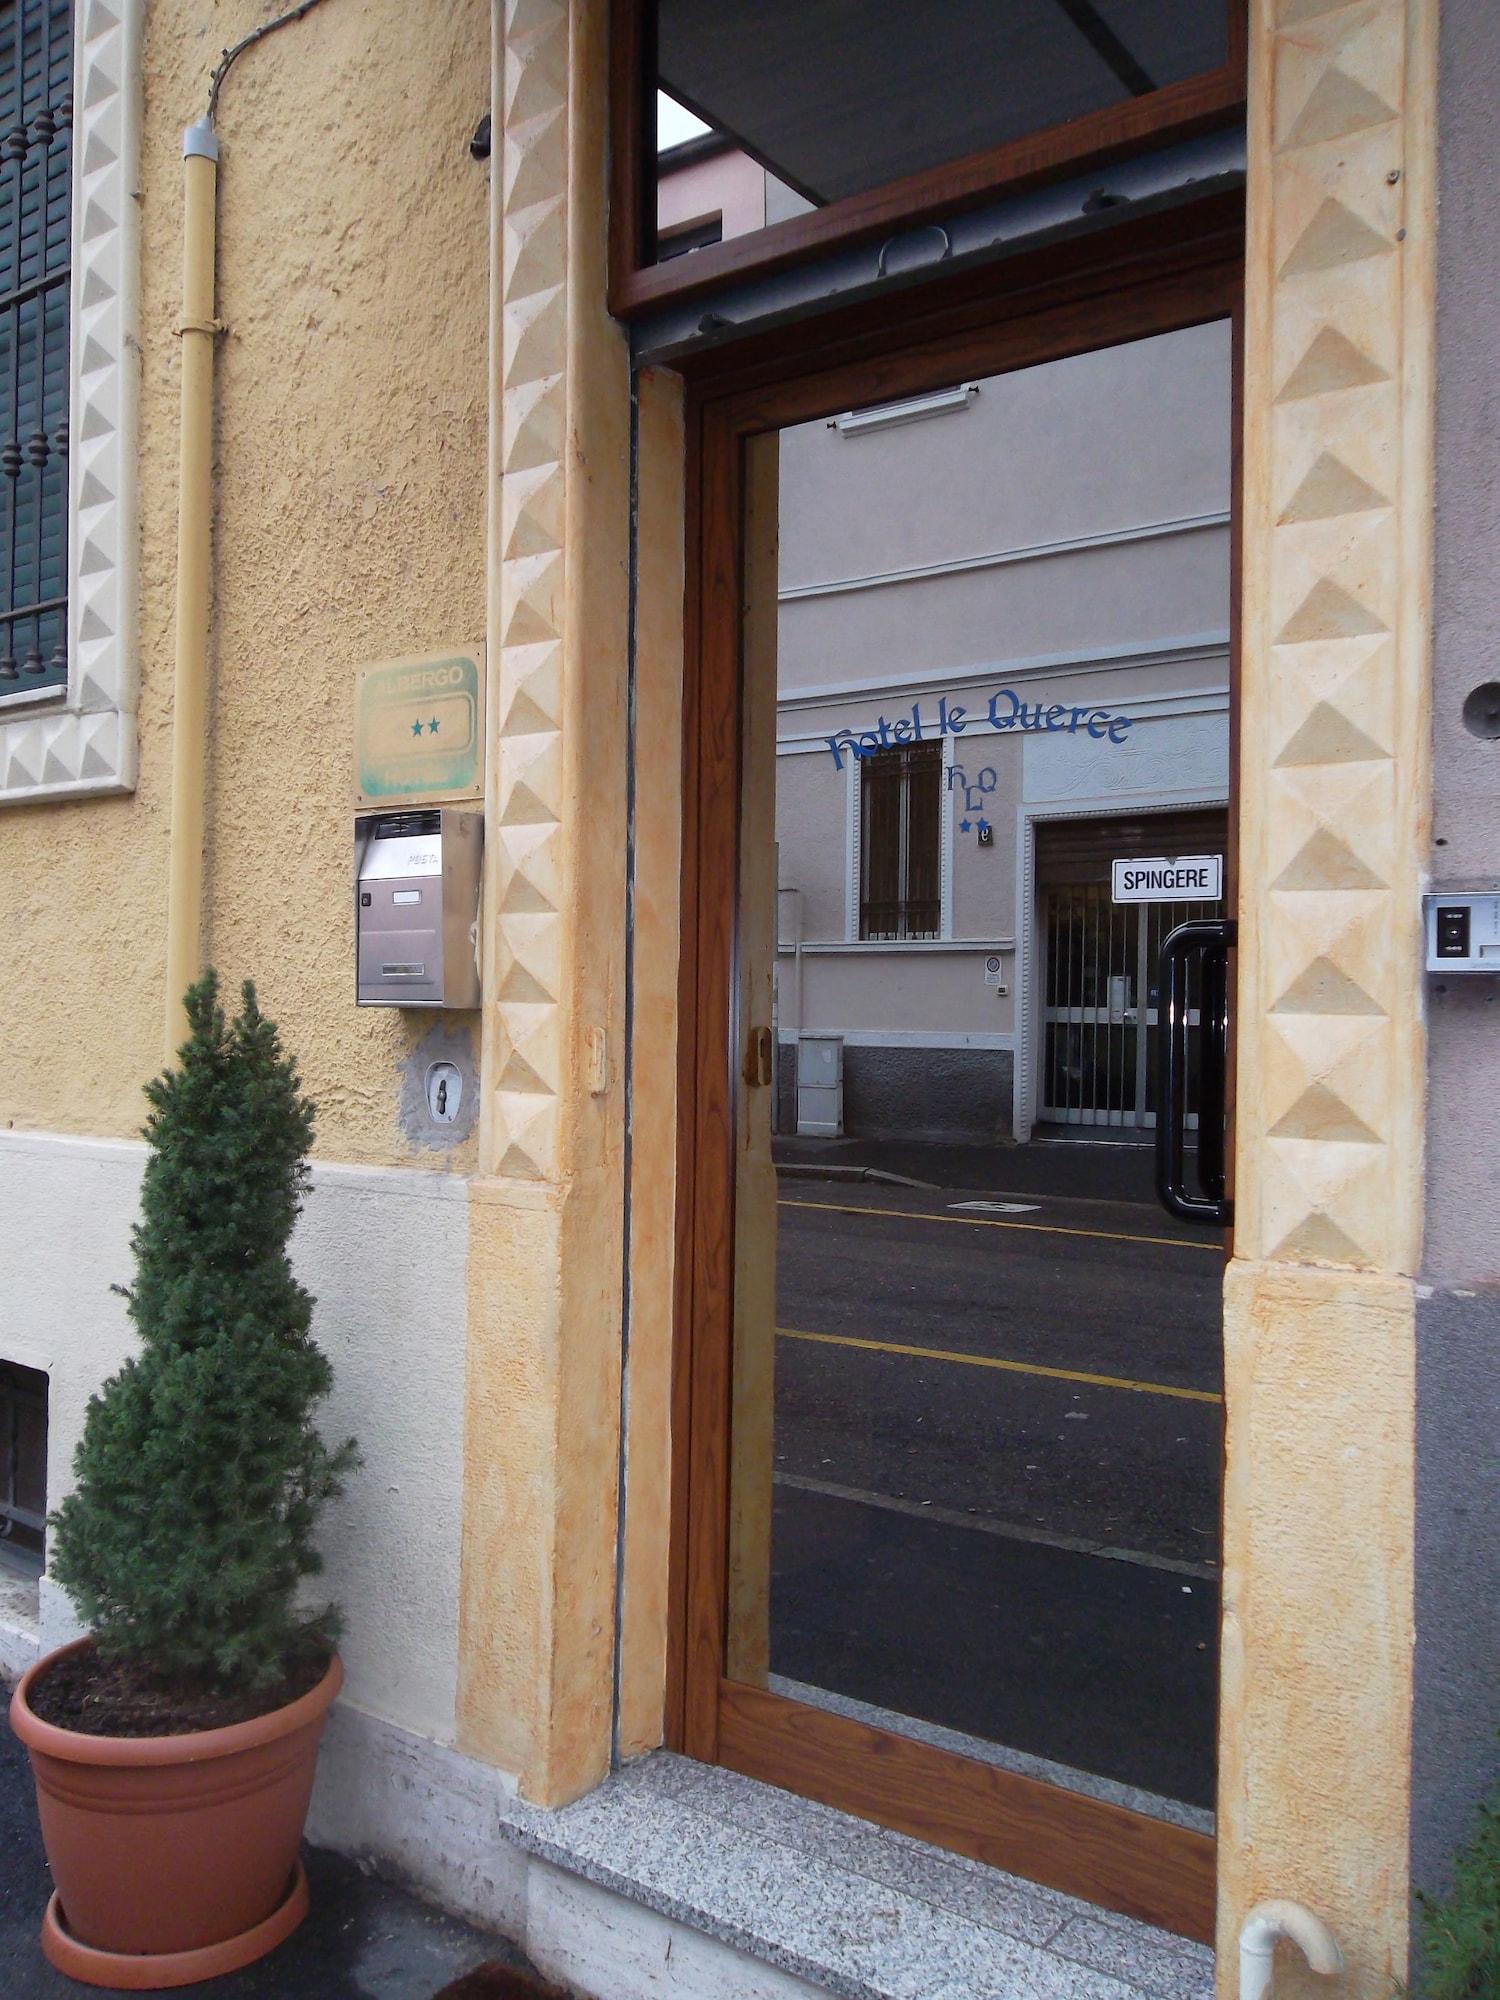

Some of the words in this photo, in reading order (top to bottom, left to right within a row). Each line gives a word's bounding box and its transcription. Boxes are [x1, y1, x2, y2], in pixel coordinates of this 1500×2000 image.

[371, 665, 465, 693] LBERGO
[938, 696, 967, 734] le
[987, 689, 1133, 744] Querce
[1124, 868, 1209, 890] SPINGERE
